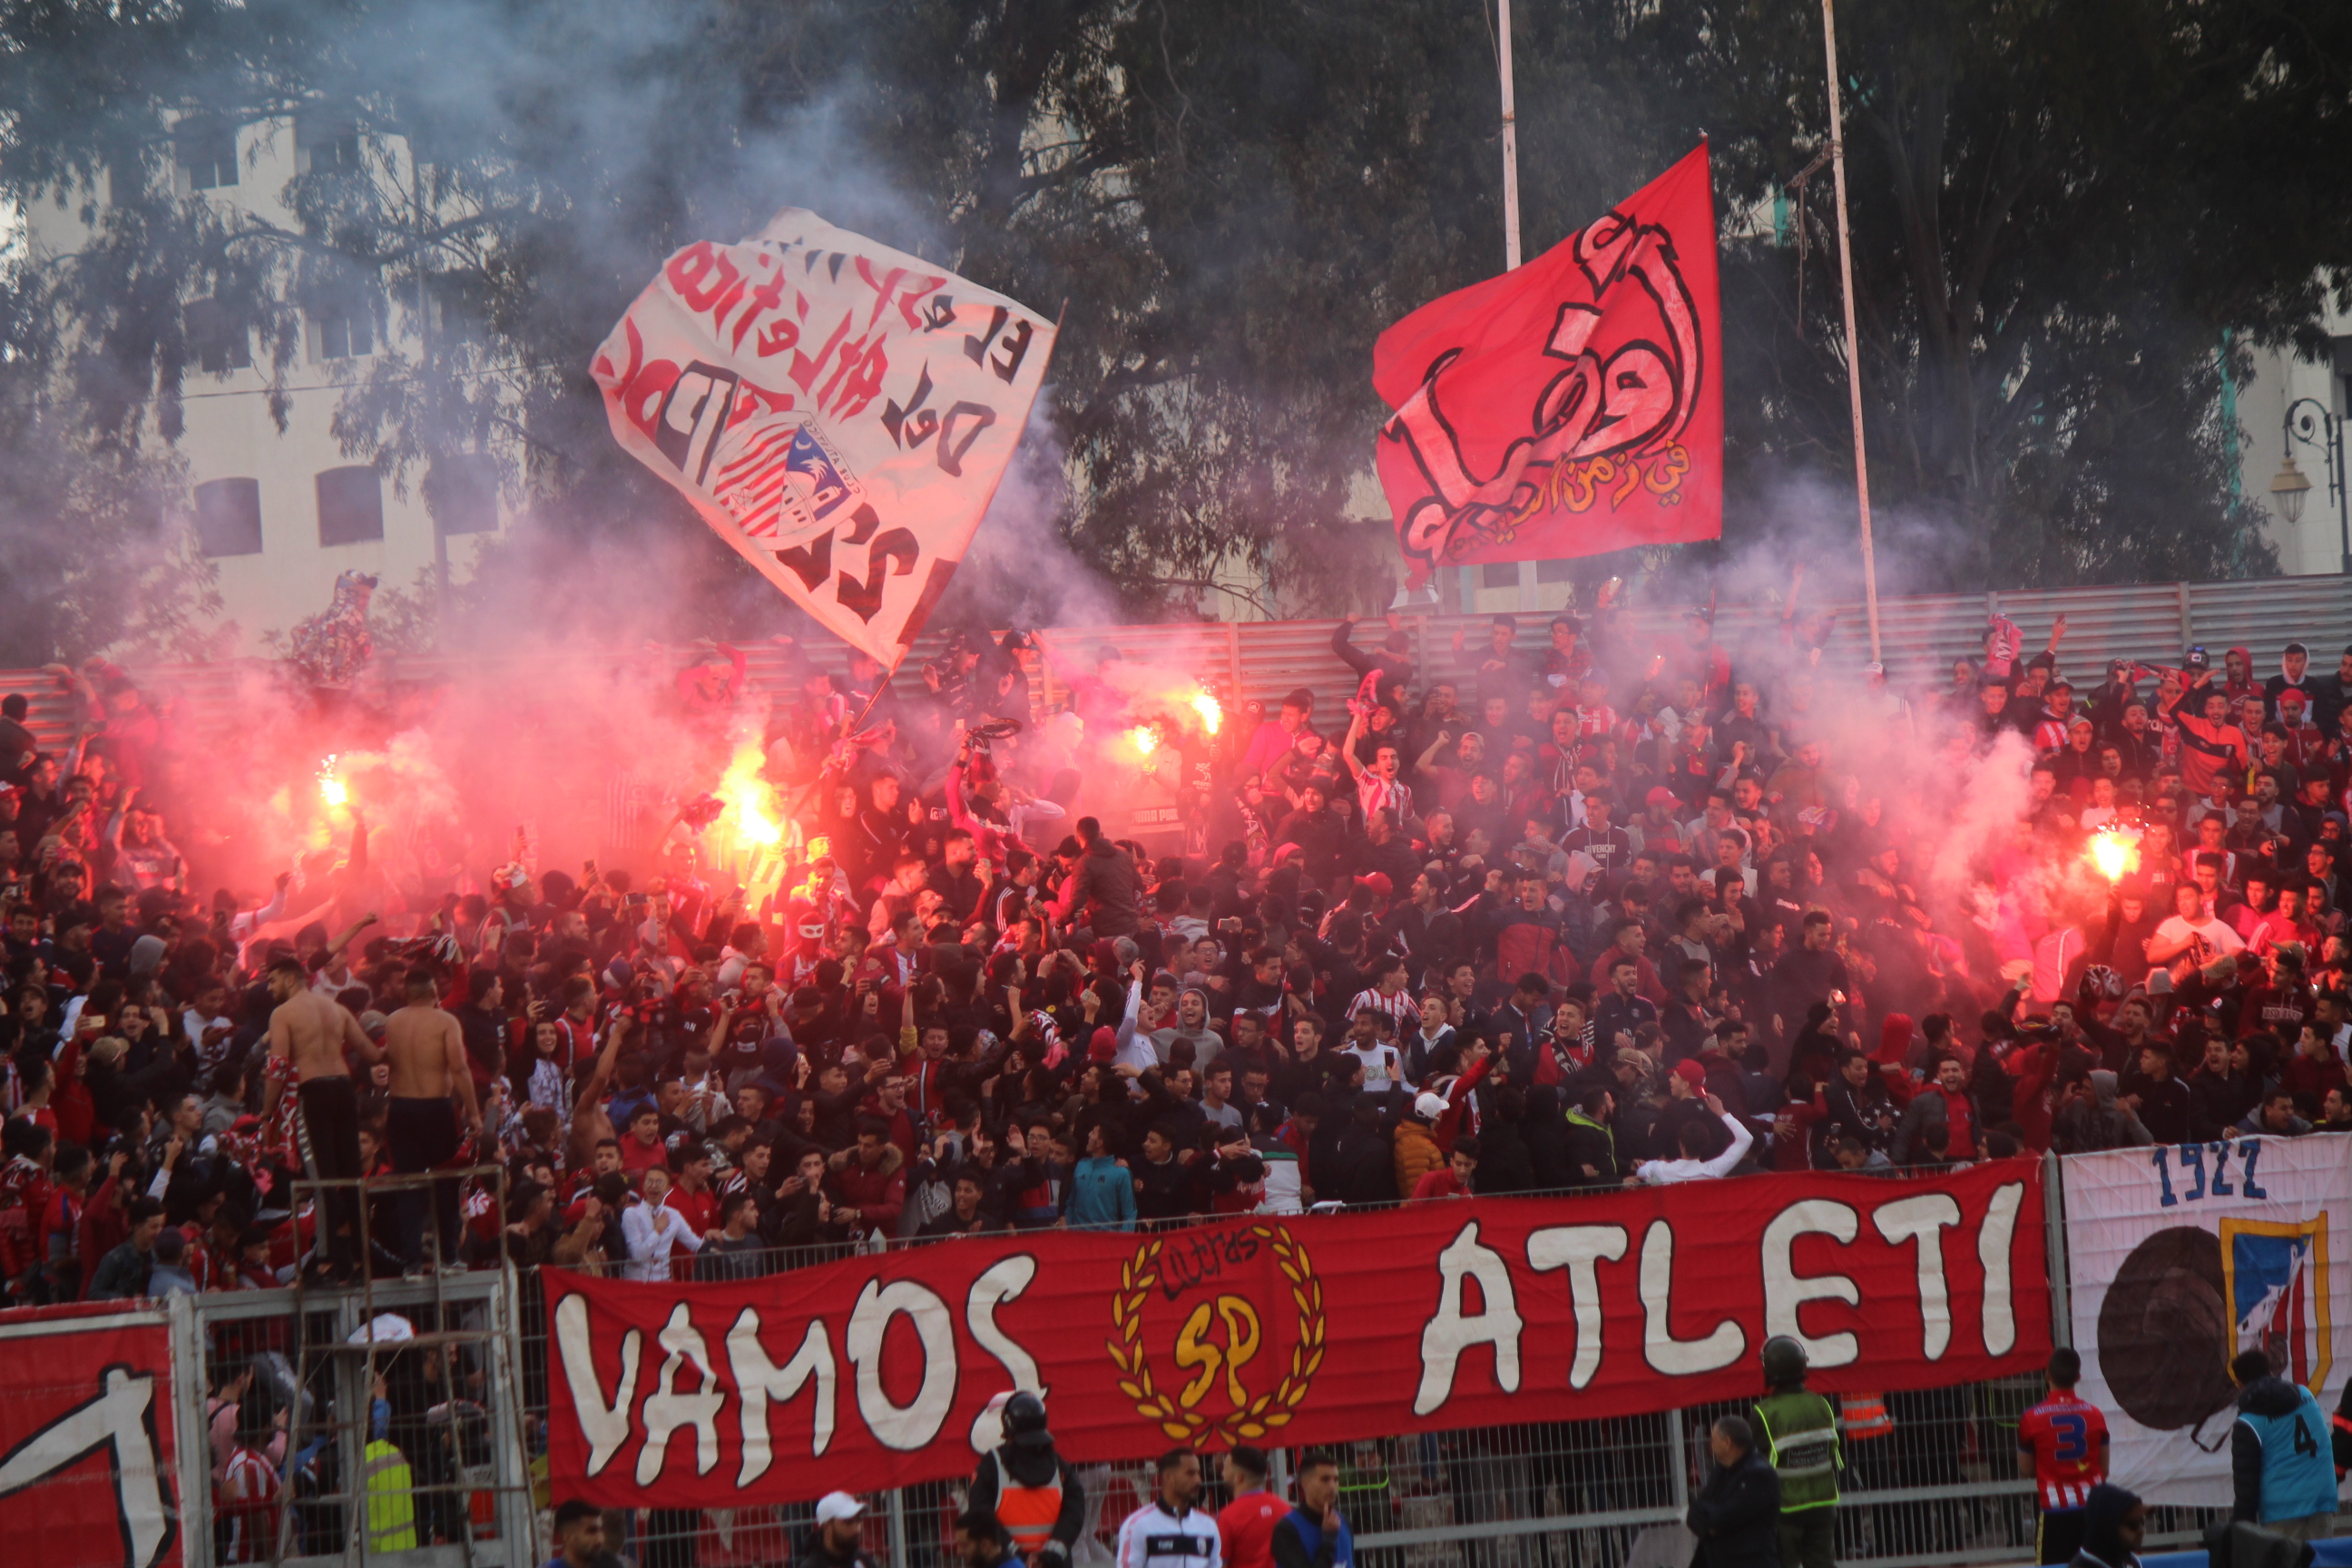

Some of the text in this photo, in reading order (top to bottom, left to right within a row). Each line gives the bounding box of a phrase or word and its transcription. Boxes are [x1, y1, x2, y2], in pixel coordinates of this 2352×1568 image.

[1645, 438, 1690, 506] في
[1584, 844, 1616, 853] GIVENCHY
[2152, 1139, 2267, 1207] 1922
[555, 1180, 2024, 1488] VAMOS ATLETI
[1175, 1295, 1261, 1408] SP
[2050, 1414, 2088, 1461] 3
[2294, 1413, 2319, 1458] 4
